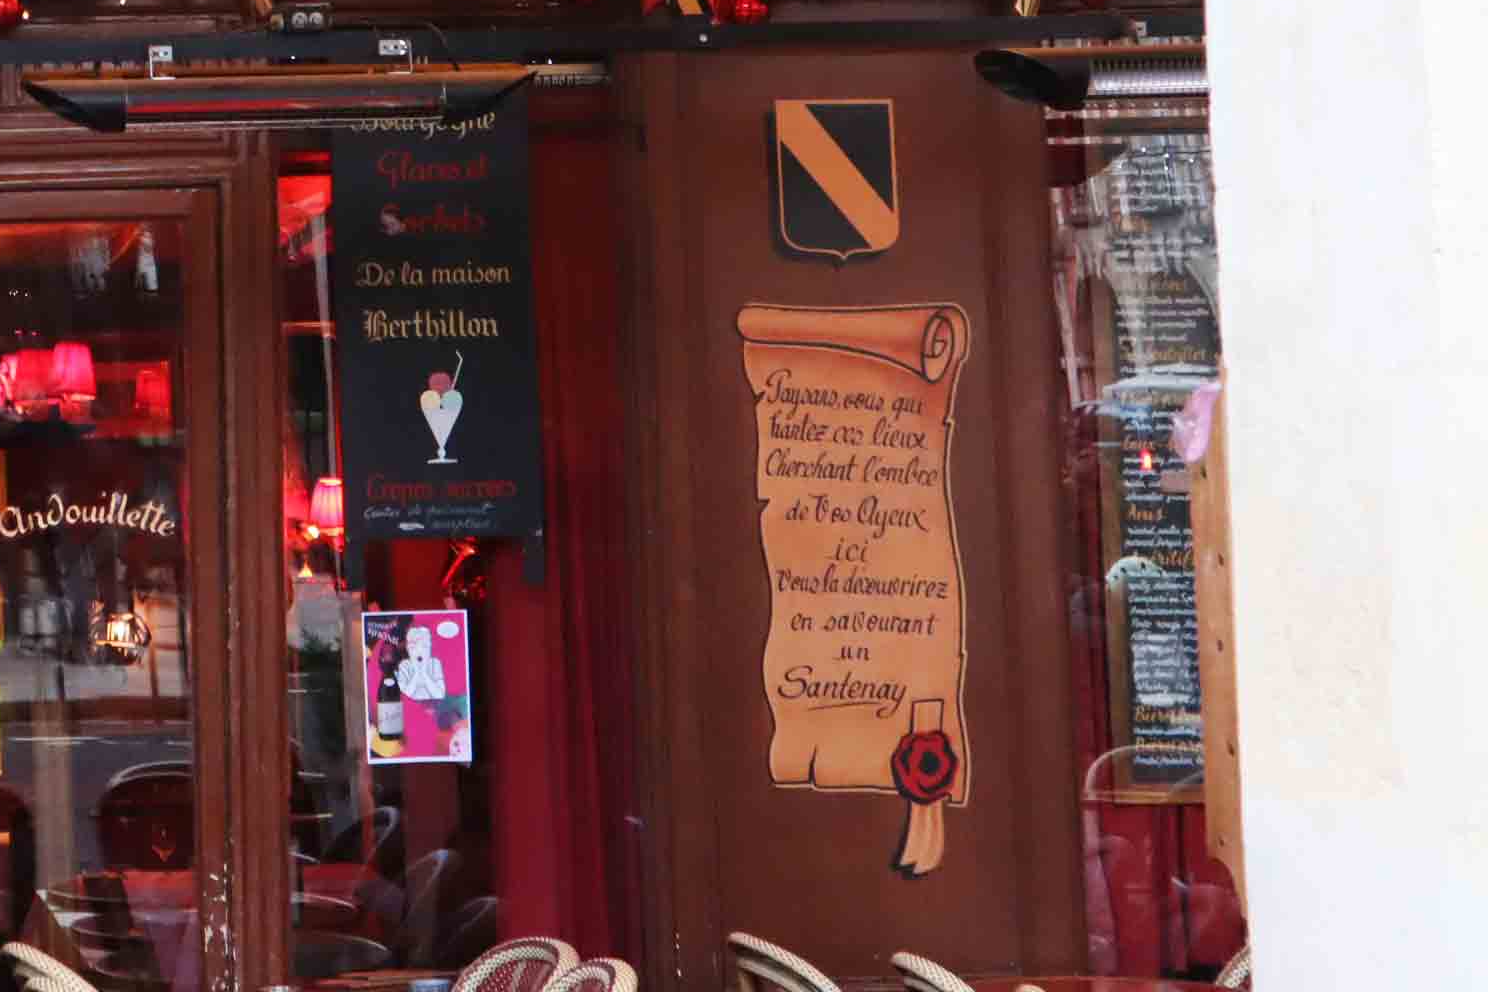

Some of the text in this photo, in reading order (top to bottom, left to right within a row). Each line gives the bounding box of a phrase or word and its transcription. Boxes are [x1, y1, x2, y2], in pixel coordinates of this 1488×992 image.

[355, 259, 511, 287] De la maison
[362, 309, 499, 342] Berthillon
[892, 396, 923, 420] qui
[769, 411, 928, 449] hantez ces lieux
[765, 448, 858, 482] Cherchant
[785, 499, 809, 521] de
[857, 495, 929, 538] Ayeux
[830, 537, 869, 563] ici
[776, 569, 817, 594] Vous
[823, 563, 839, 594] la
[790, 611, 937, 635] en savourant
[838, 644, 870, 661] un
[777, 665, 907, 719] Santenay
